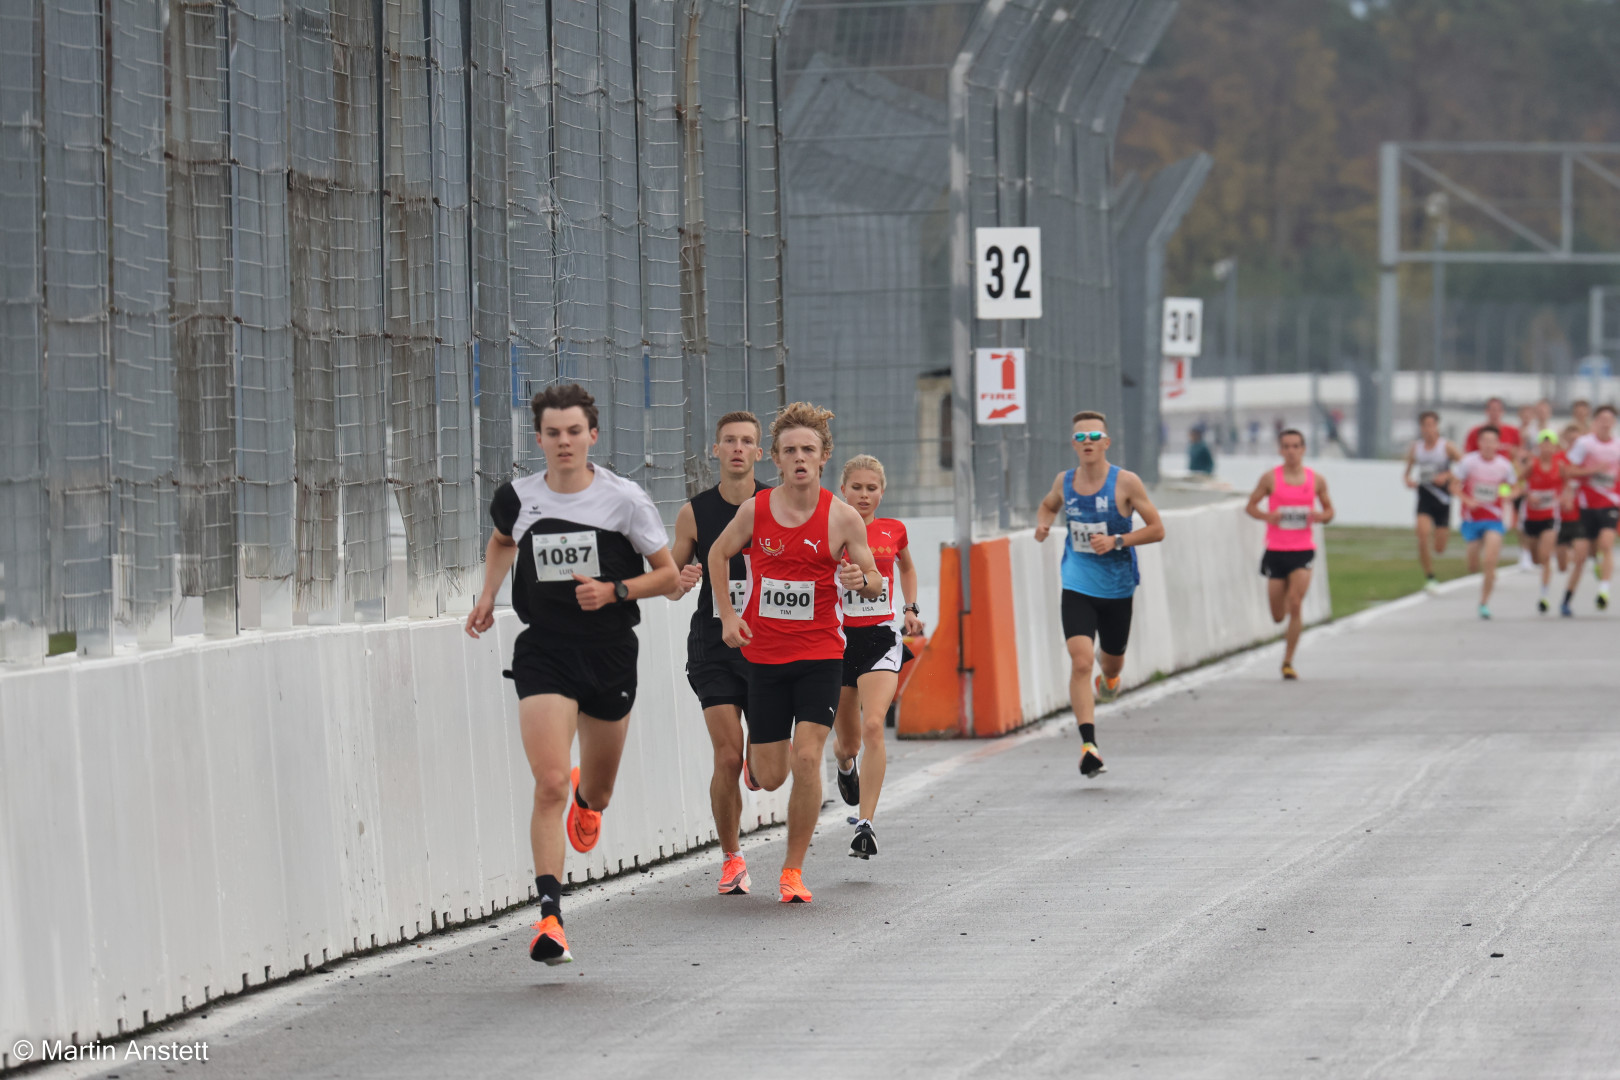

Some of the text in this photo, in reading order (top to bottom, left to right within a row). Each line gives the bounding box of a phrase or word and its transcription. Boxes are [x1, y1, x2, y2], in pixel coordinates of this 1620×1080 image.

[986, 246, 1031, 299] 32
[1169, 310, 1194, 342] 30
[1074, 531, 1104, 542] 11
[538, 546, 592, 566] 1087
[764, 590, 810, 607] 1090
